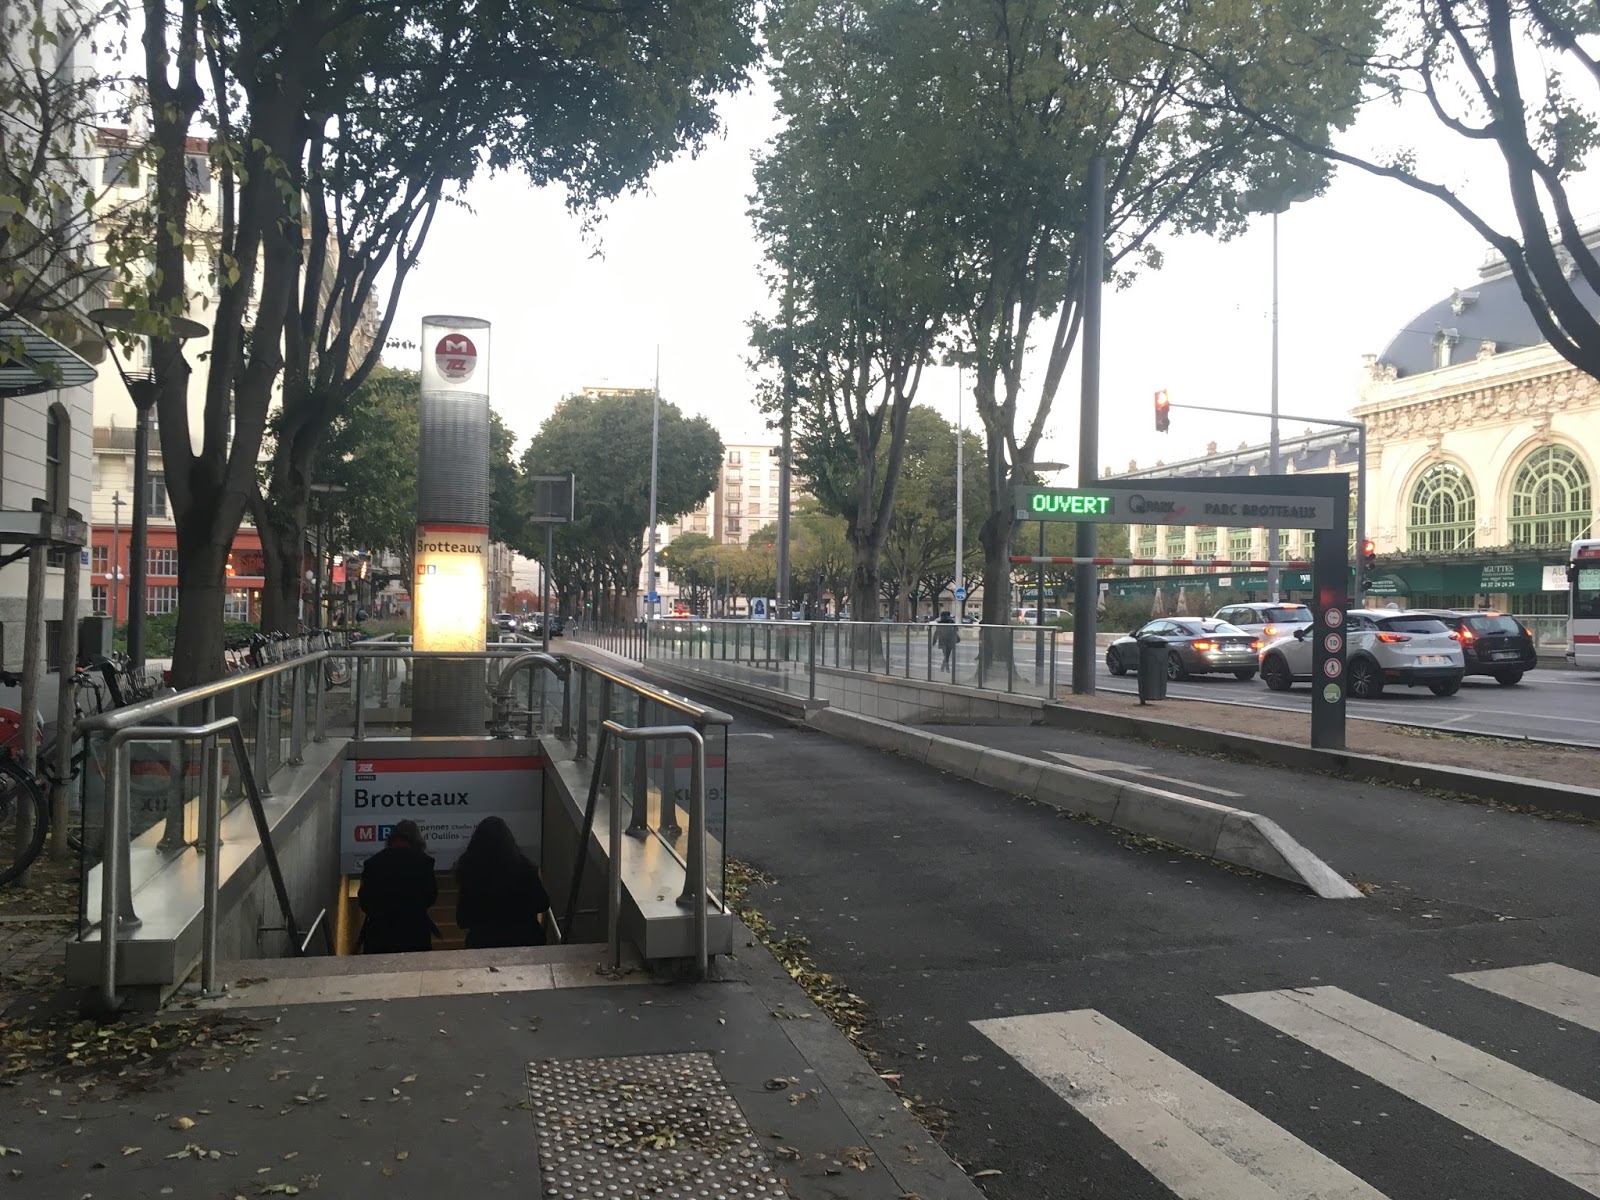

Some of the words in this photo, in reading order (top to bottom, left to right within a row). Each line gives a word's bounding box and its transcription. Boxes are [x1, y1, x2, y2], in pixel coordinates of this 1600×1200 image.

[445, 340, 467, 353] M
[1032, 494, 1110, 514] OUVERT
[1204, 503, 1238, 516] PARC
[1242, 504, 1316, 519] BROTTEAUX
[417, 540, 482, 554] Brotteaux
[1482, 565, 1514, 573] AGUTTES
[354, 788, 469, 808] Brotteaux
[359, 827, 373, 839] M
[419, 823, 450, 832] pennes
